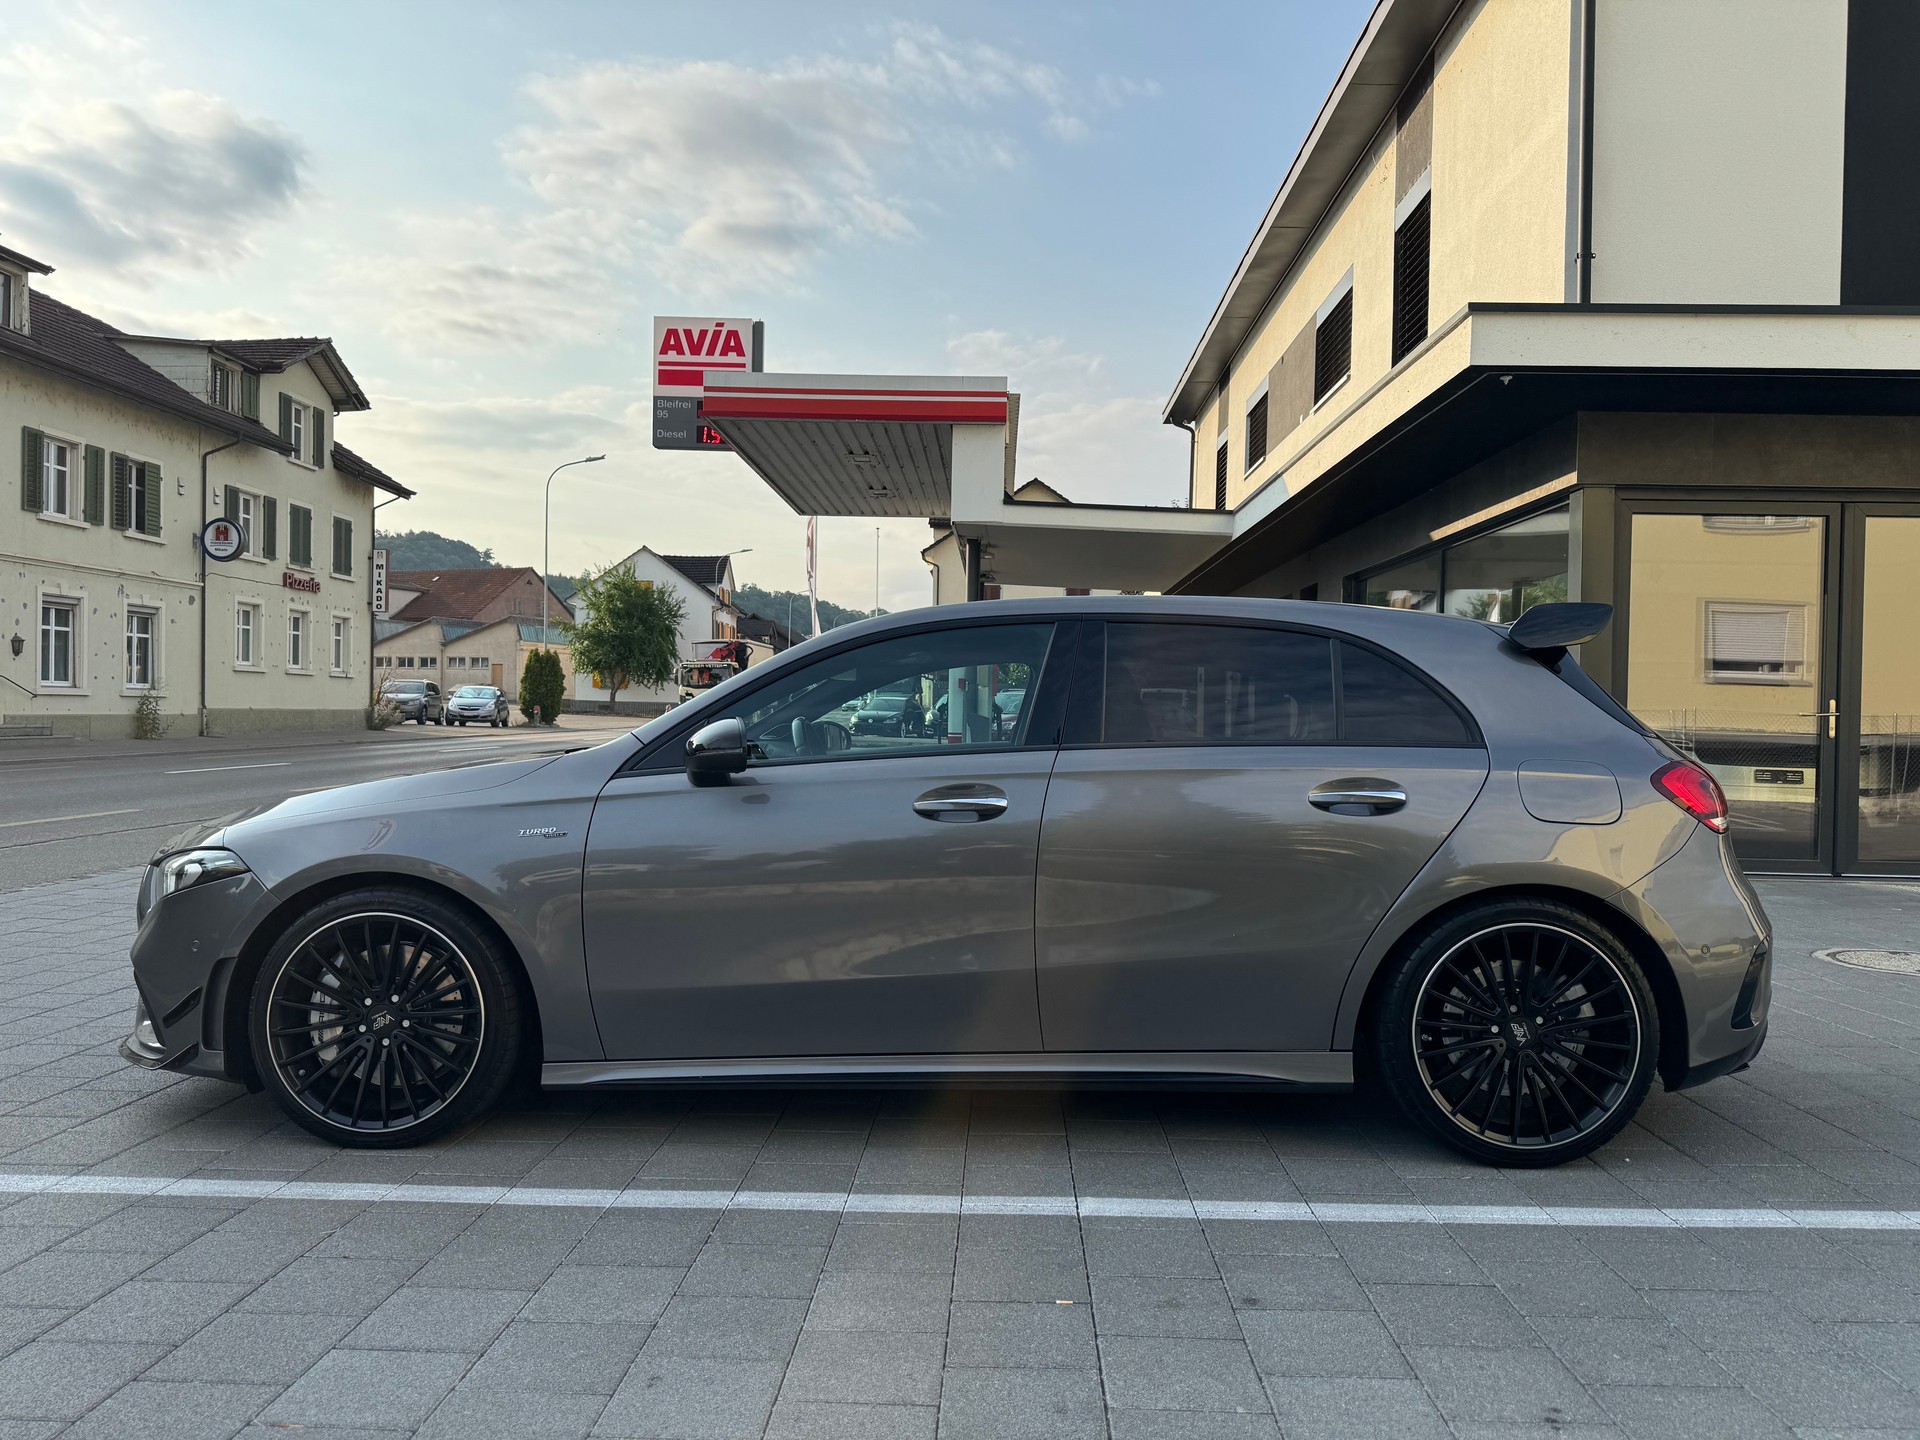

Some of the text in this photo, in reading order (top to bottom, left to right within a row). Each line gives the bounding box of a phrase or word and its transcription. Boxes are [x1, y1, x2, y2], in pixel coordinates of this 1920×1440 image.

[657, 400, 691, 409] Bleifrei
[657, 410, 669, 418] 95
[657, 430, 687, 438] Diesel
[376, 564, 384, 610] MIKADO
[519, 827, 557, 835] TURBO
